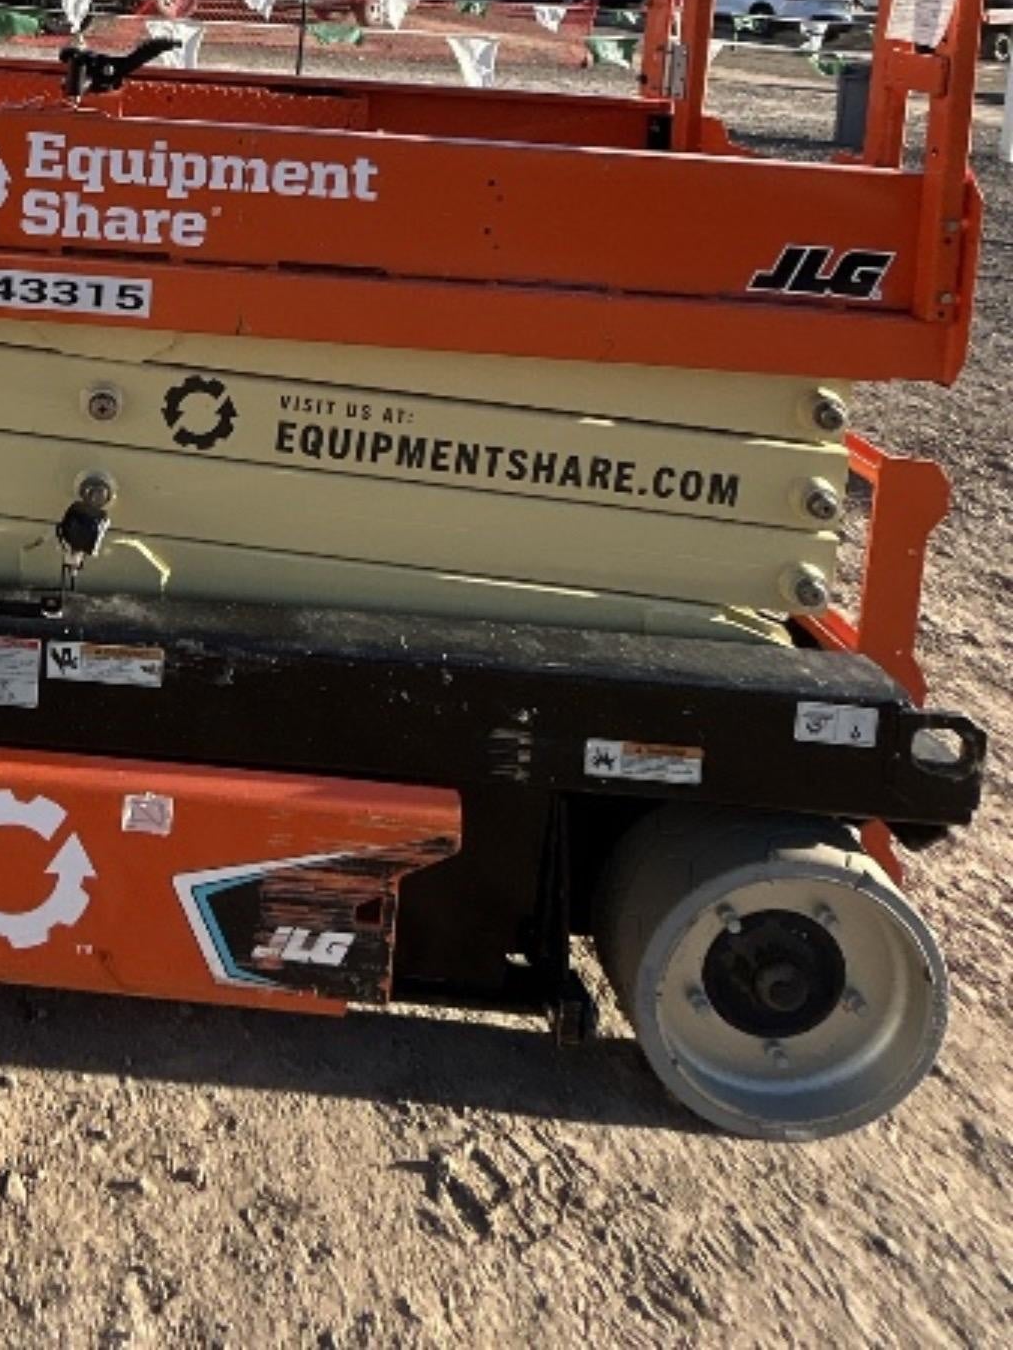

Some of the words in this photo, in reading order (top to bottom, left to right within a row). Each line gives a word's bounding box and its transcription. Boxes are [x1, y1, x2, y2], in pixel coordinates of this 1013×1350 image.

[25, 131, 379, 200] Equipment
[20, 188, 208, 247] Share
[745, 243, 897, 300] JLG
[280, 395, 336, 415] VISIT
[346, 402, 373, 421] US
[382, 407, 415, 424] AT:
[274, 419, 742, 507] EQUIPMENTSHARE.COM
[251, 925, 356, 967] JLG
